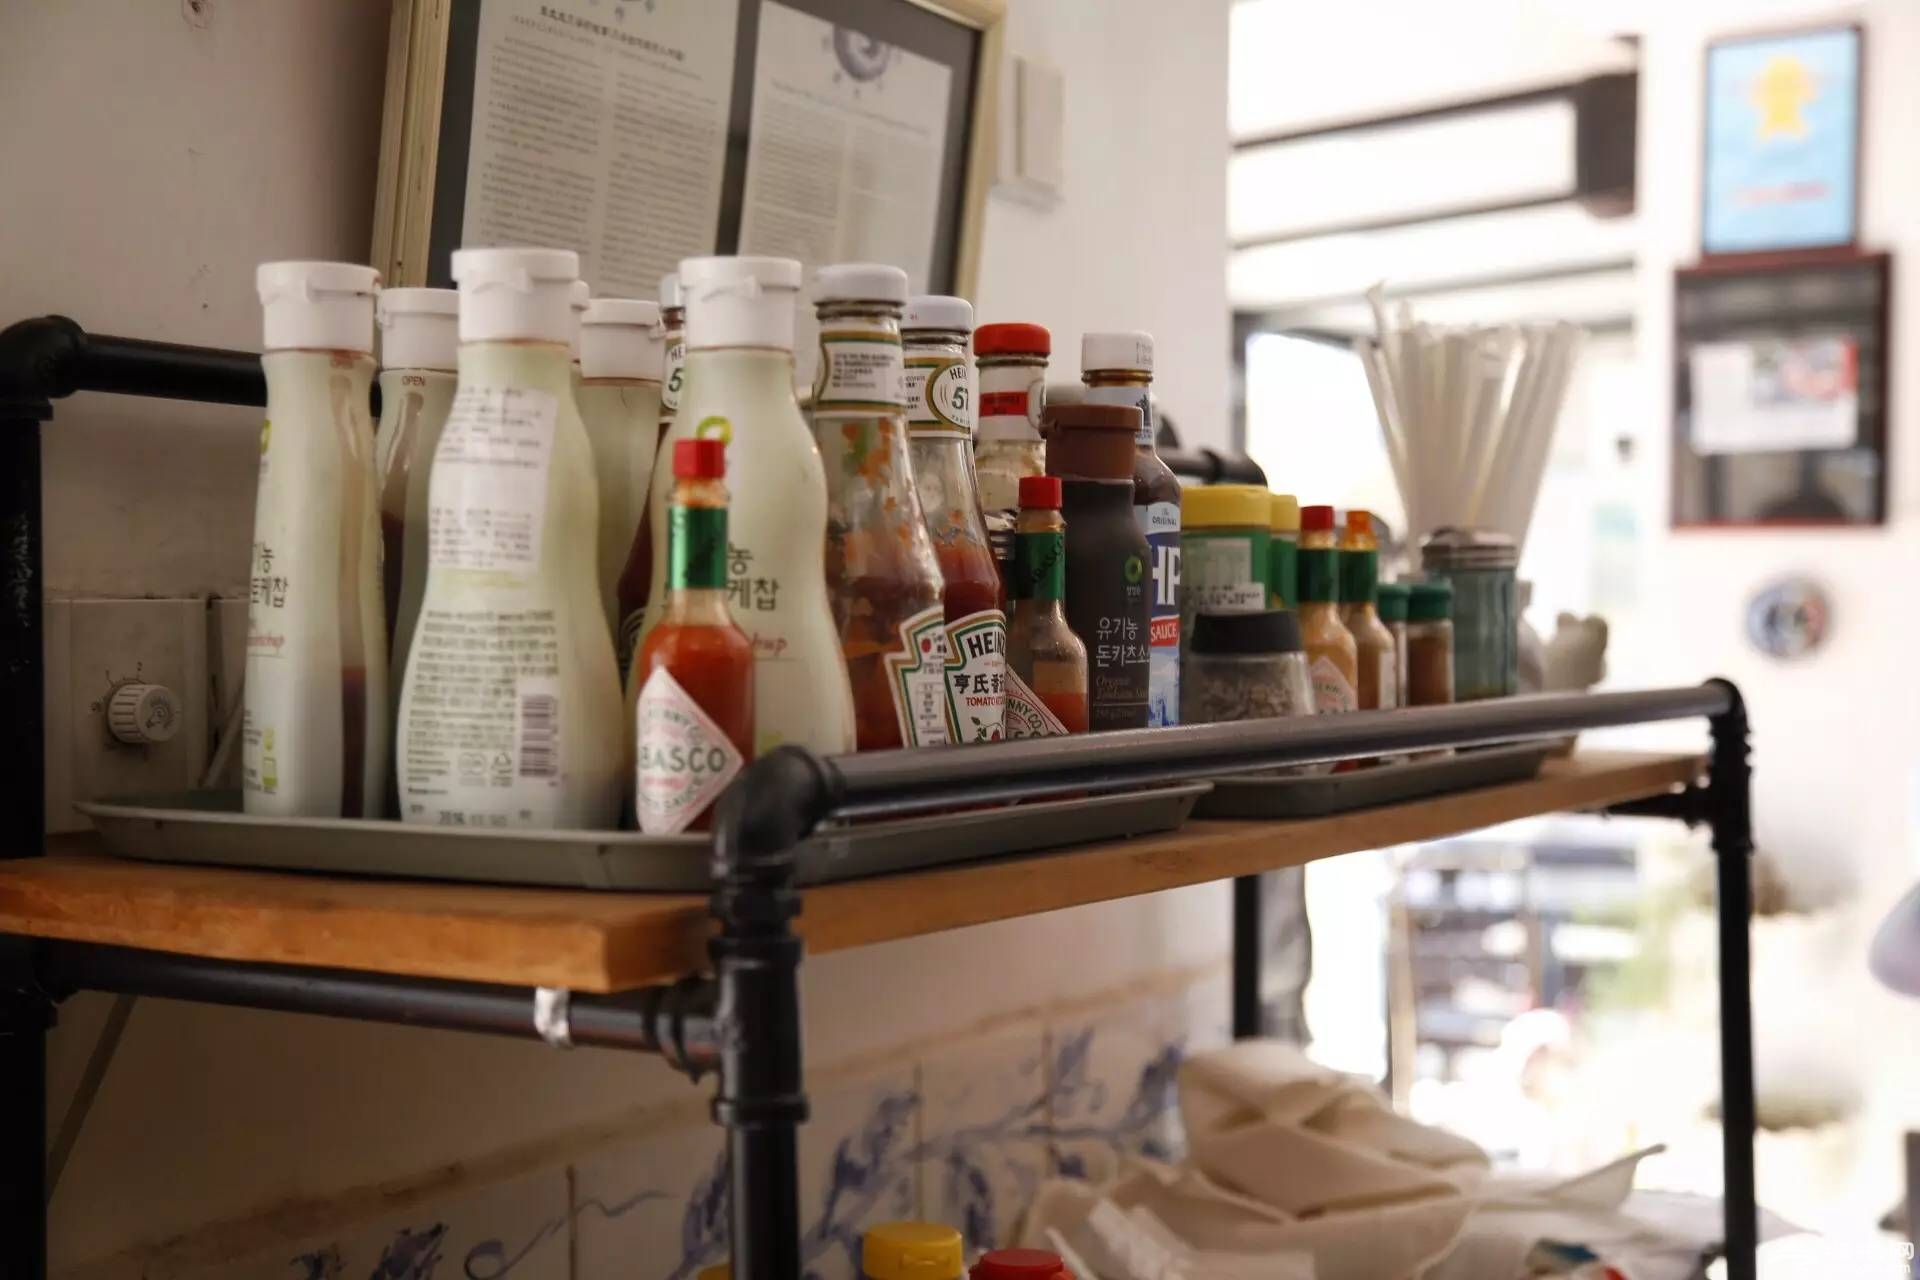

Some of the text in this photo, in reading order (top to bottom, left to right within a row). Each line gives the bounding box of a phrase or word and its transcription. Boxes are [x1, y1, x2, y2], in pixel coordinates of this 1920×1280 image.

[402, 376, 425, 387] OPEN
[1096, 616, 1139, 641] 유기농
[1150, 622, 1178, 643] SAUCE
[1096, 643, 1150, 668] 돈카츠소
